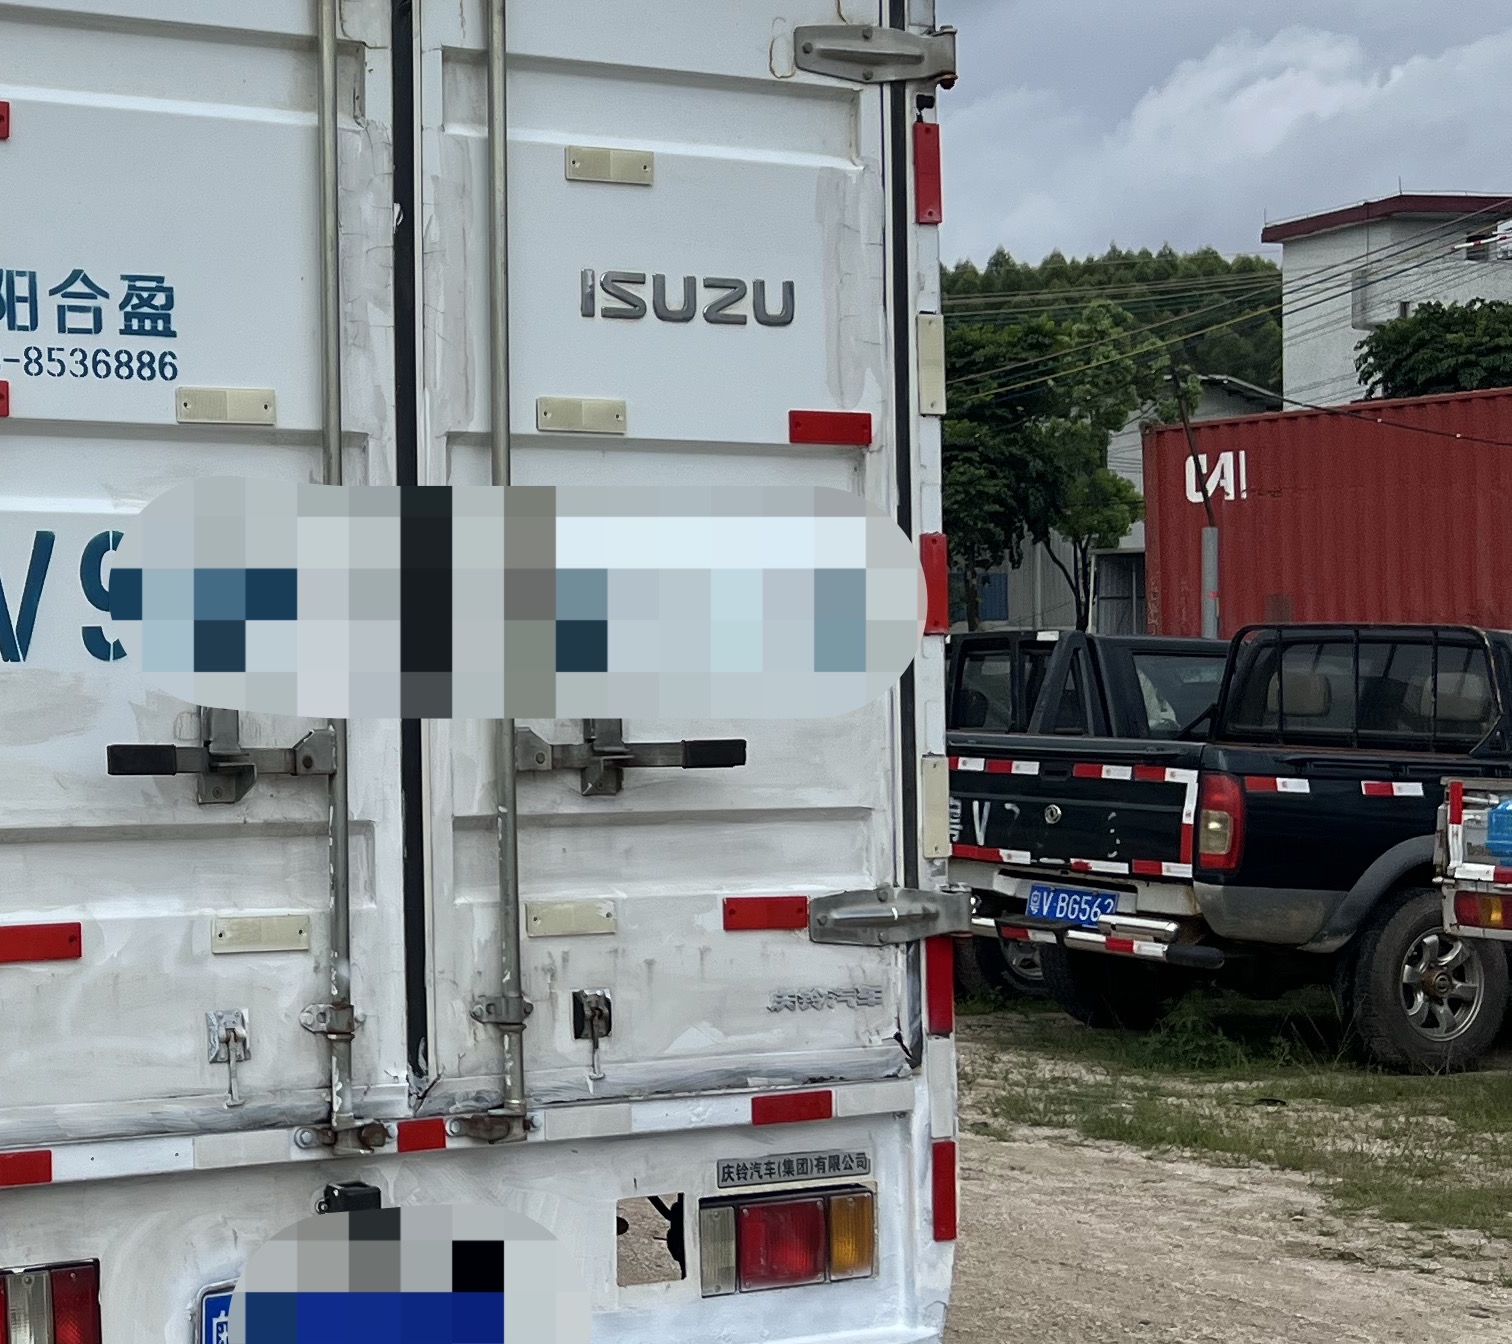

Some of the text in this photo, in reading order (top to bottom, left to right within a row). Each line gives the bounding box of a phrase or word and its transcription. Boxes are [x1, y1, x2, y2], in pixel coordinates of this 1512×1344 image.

[580, 268, 795, 327] ISUZU
[721, 1152, 868, 1183] 庆铃汽车(集团)有限公司
